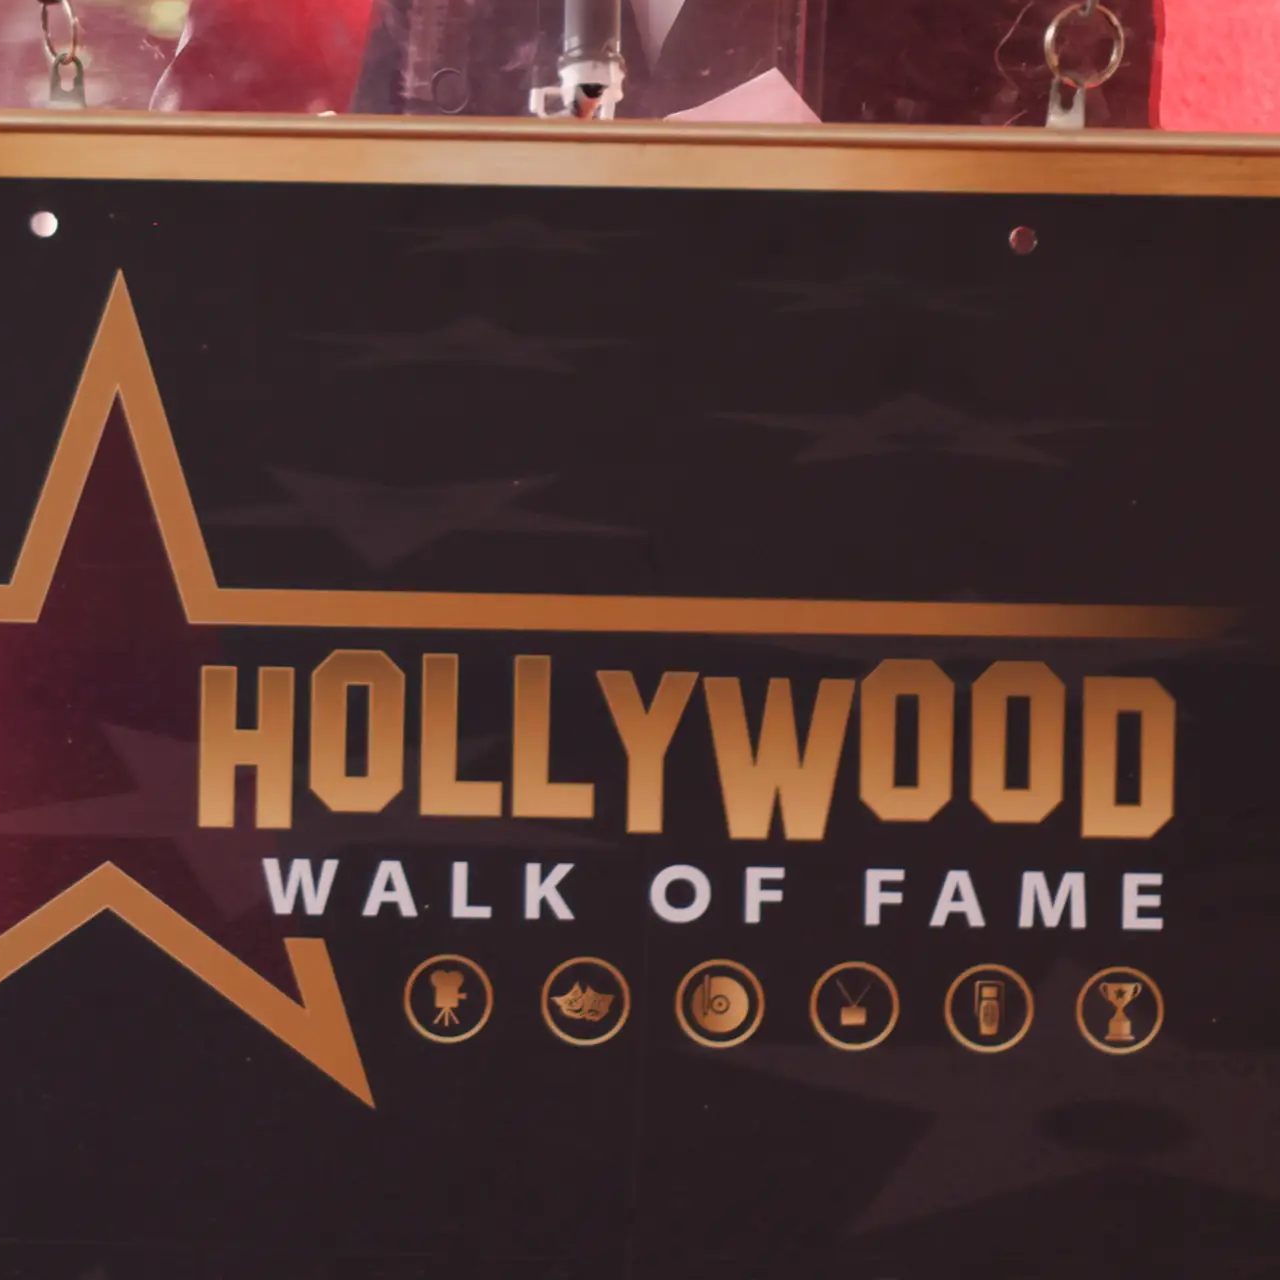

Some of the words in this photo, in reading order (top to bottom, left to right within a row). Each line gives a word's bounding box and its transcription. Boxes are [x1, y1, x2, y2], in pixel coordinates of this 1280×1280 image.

[198, 649, 1176, 841] HOLLYWOOD
[262, 857, 576, 920] WALK
[649, 864, 785, 923] OF
[864, 868, 1164, 930] FAME
